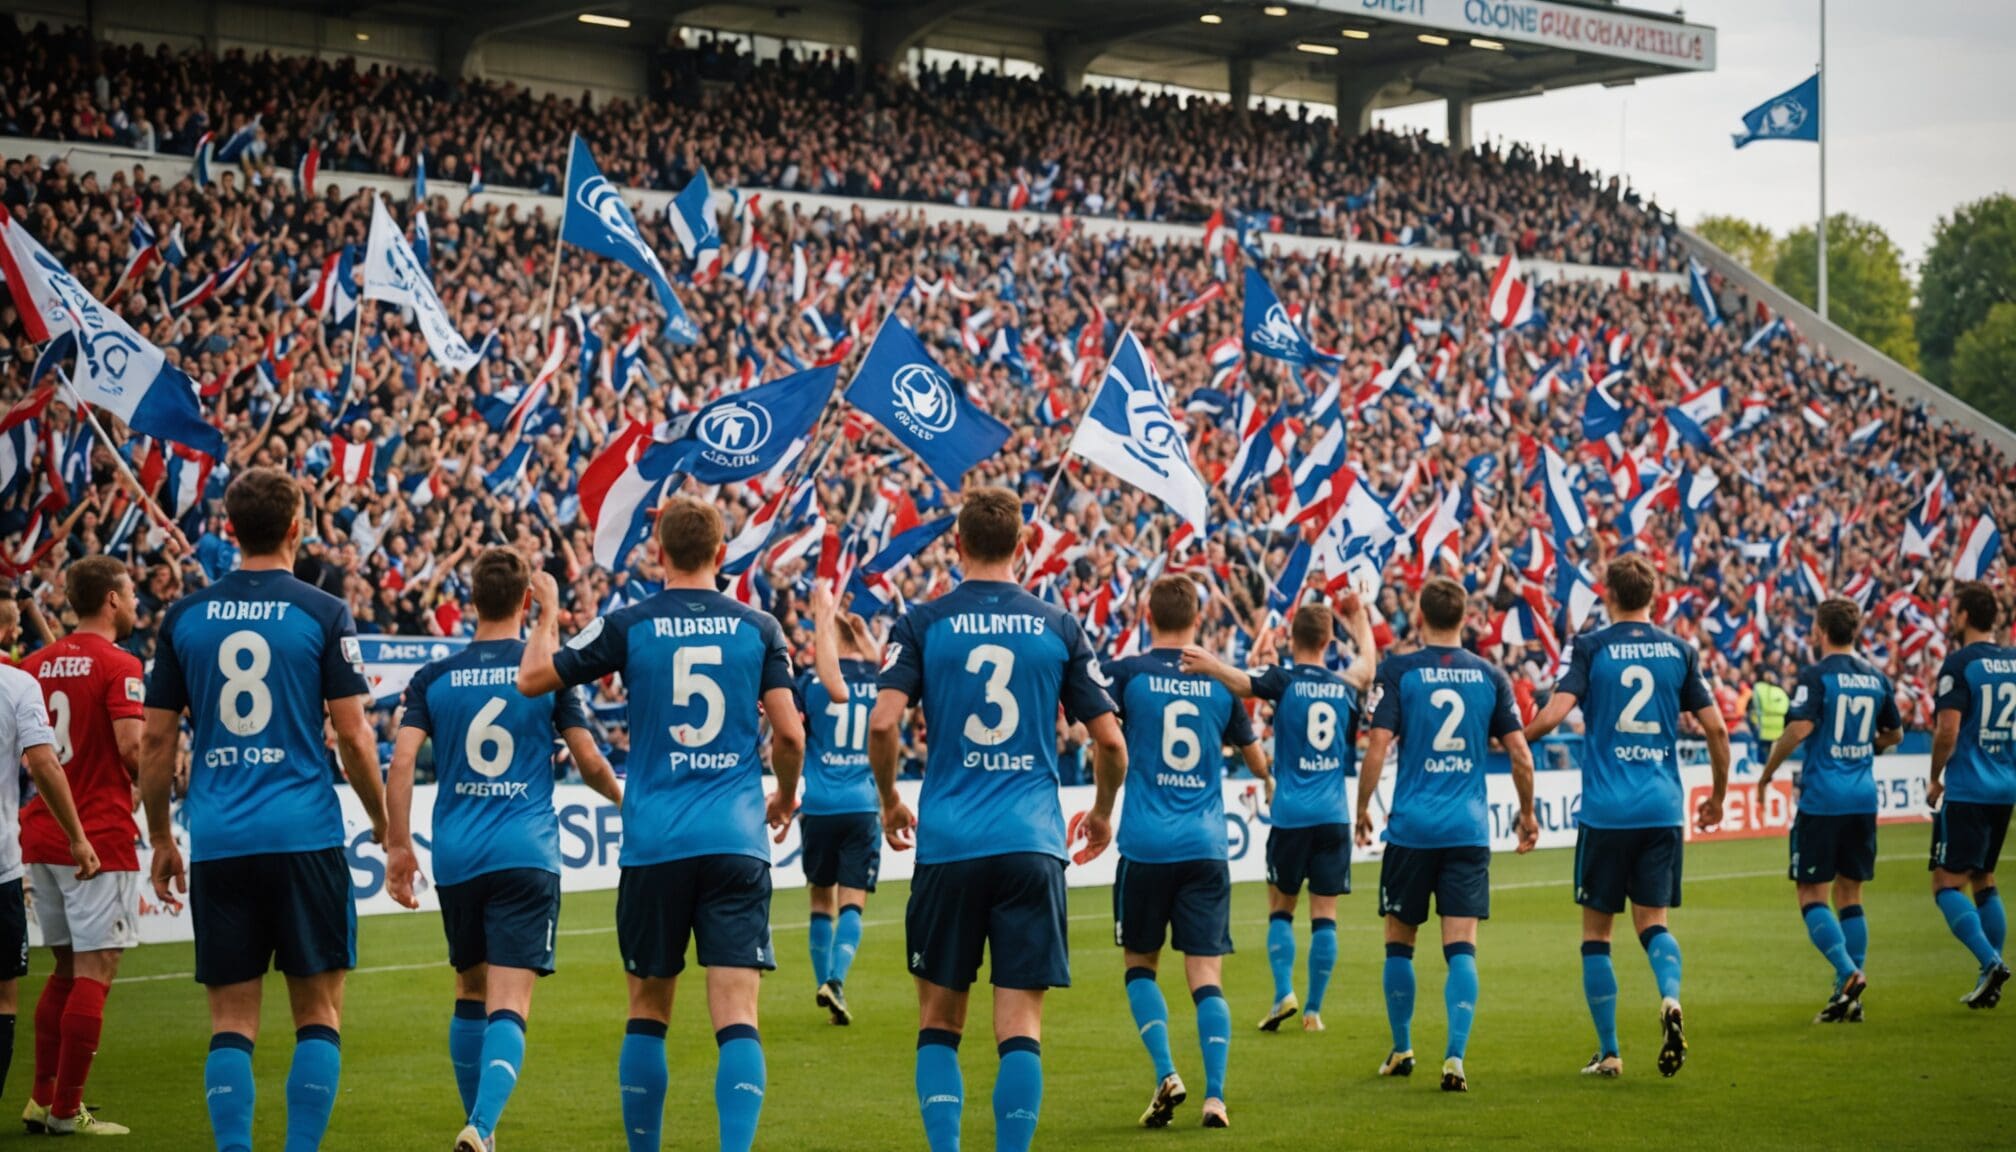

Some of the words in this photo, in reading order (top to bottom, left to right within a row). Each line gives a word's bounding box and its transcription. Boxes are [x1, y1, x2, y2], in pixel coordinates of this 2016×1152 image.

[218, 630, 272, 736] 8
[669, 645, 726, 747] 5
[963, 644, 1020, 745] 3
[1430, 688, 1466, 752] 2
[1615, 665, 1661, 734] 2
[465, 697, 515, 777] 6
[1162, 700, 1201, 772] 6
[1307, 701, 1337, 751] 8
